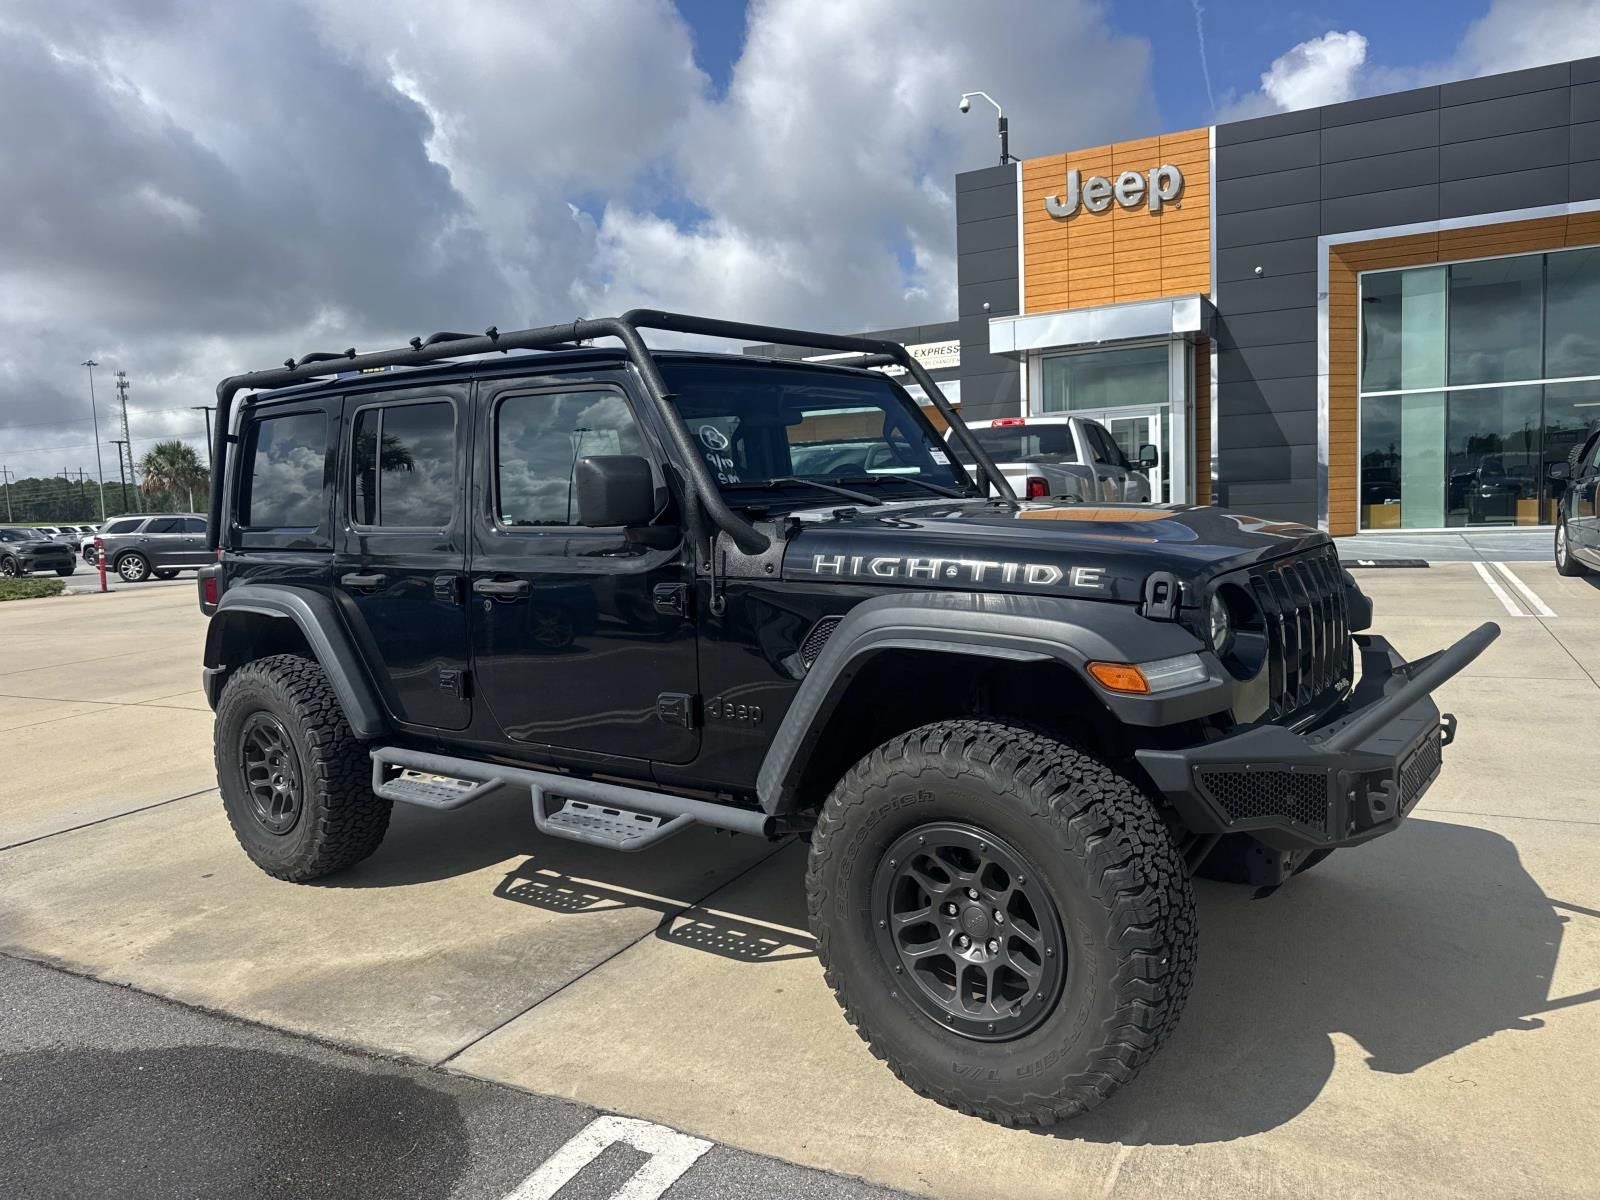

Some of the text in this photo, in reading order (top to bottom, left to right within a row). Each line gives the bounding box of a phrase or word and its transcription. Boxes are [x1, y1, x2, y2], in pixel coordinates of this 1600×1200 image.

[1044, 163, 1184, 218] Jeep
[914, 345, 960, 357] EXPRESS
[812, 554, 1106, 590] HIGH TIDE
[707, 696, 763, 728] Jeep
